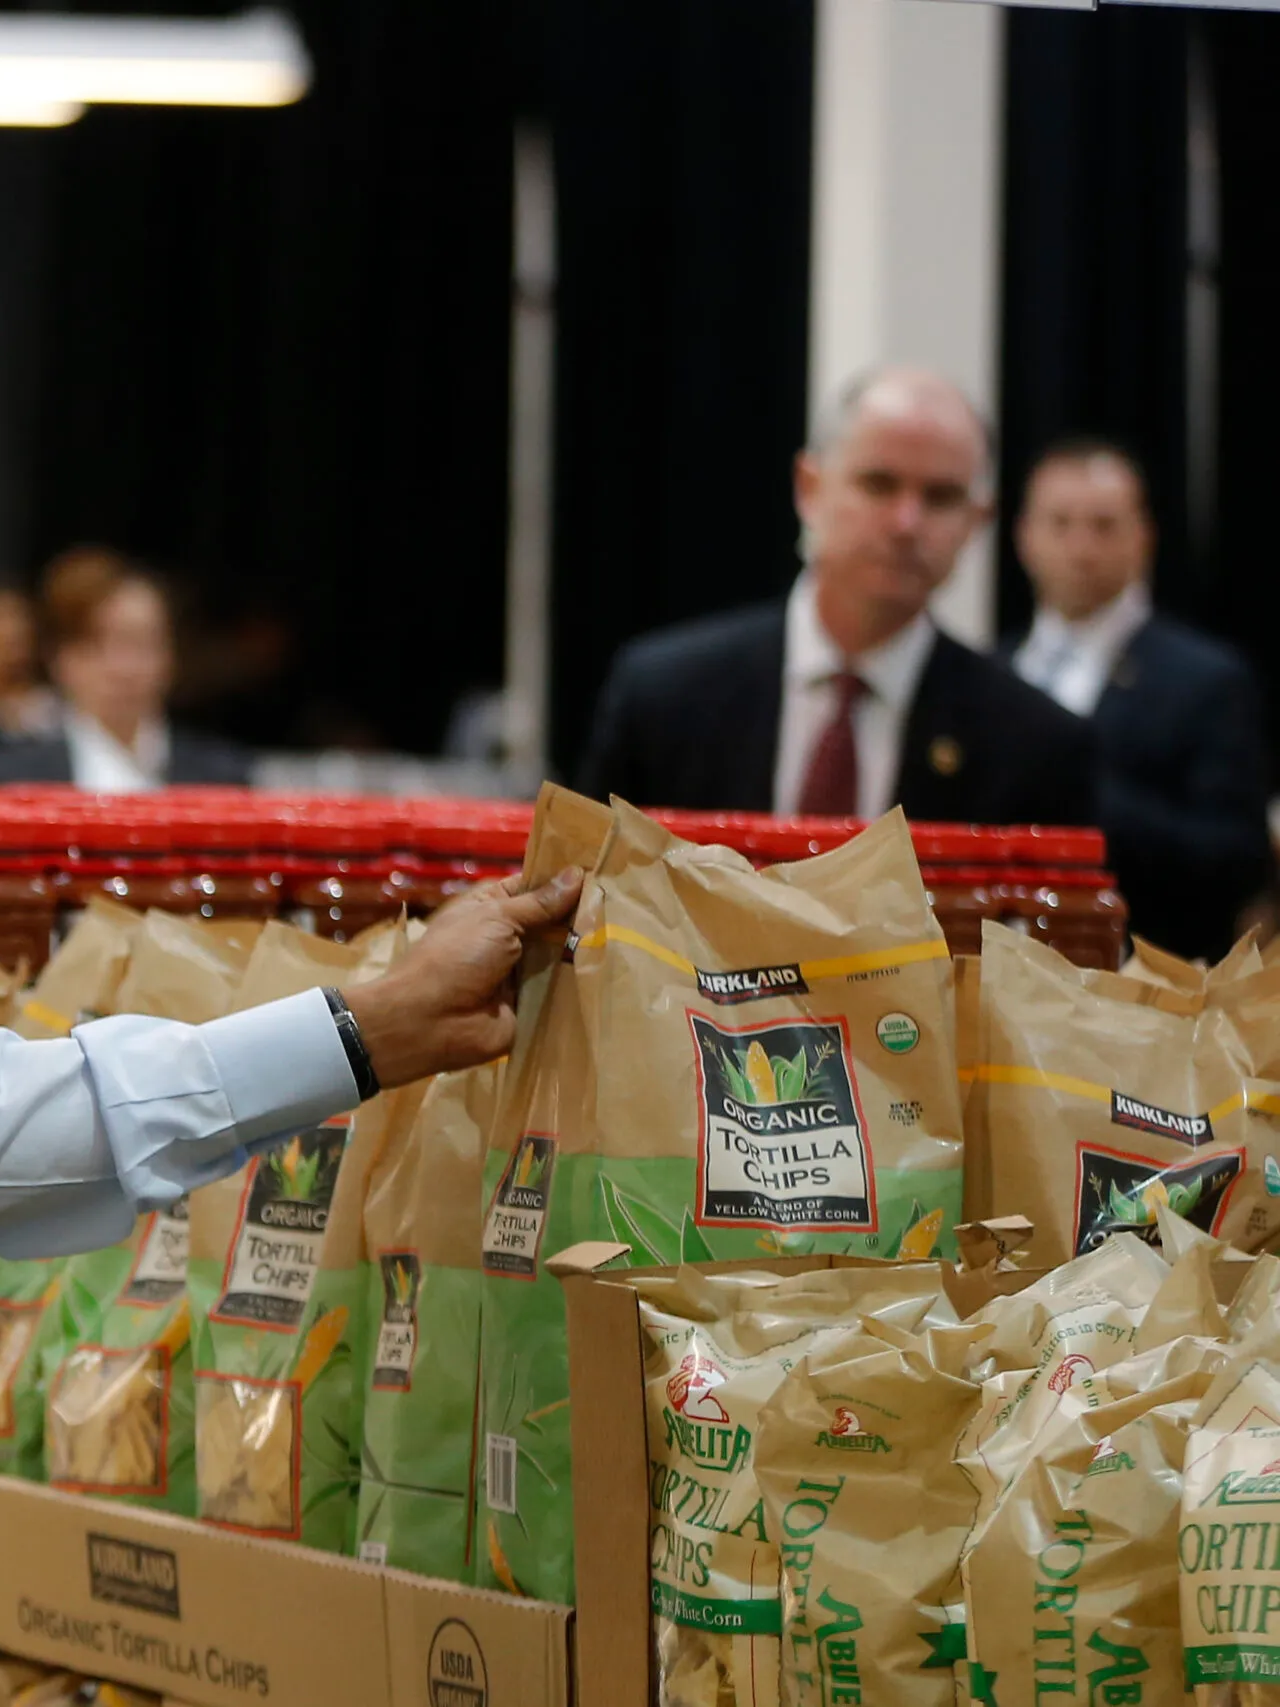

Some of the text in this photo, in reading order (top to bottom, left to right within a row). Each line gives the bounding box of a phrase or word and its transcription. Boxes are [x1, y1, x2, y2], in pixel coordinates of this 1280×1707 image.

[698, 968, 799, 993] KIRKLAND
[723, 1099, 839, 1131] ORGANIC
[1115, 1094, 1207, 1136] KIRKLAND
[716, 1127, 852, 1166] TORTILLA
[743, 1160, 831, 1190] CHIPS
[714, 1204, 768, 1217] YELLOW
[776, 1209, 822, 1222] WHITE
[825, 1209, 860, 1220] CORN
[253, 1262, 310, 1291] CHIPS
[651, 1524, 713, 1588] CHIPS
[702, 1604, 743, 1627] Corn
[1197, 1584, 1280, 1636] CHIP
[108, 1620, 201, 1681] TORTILLA
[205, 1647, 270, 1698] CHIPS
[440, 1649, 475, 1683] USDA
